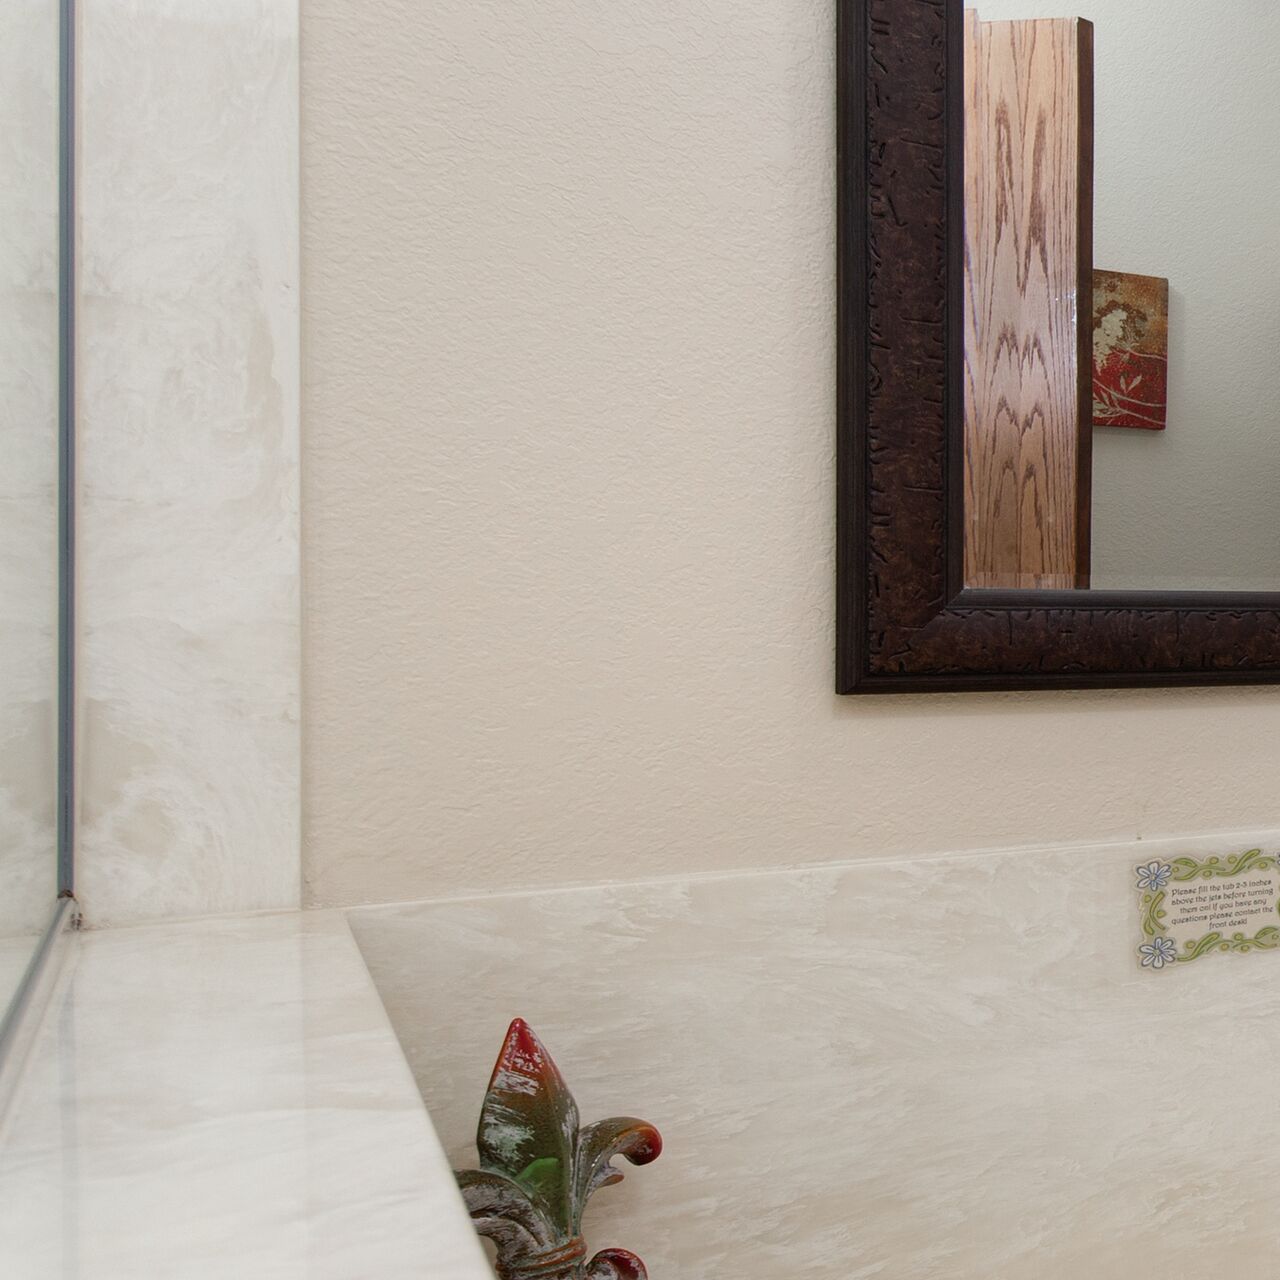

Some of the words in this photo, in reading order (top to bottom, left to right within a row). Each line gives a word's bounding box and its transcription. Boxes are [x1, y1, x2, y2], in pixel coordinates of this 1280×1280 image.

[1172, 888, 1197, 897] Please
[1198, 885, 1208, 895] fill
[1249, 879, 1272, 887] inches
[1171, 897, 1194, 906] above
[1196, 895, 1207, 903] the
[1208, 894, 1221, 902] jets
[1223, 890, 1246, 900] before
[1248, 888, 1274, 896] turning
[1180, 906, 1198, 914] them
[1219, 902, 1233, 910] you
[1235, 899, 1252, 908] have
[1253, 898, 1267, 906] any
[1171, 916, 1208, 925] questions
[1209, 911, 1233, 921] please
[1234, 908, 1261, 917] contact
[1208, 922, 1227, 930] front
